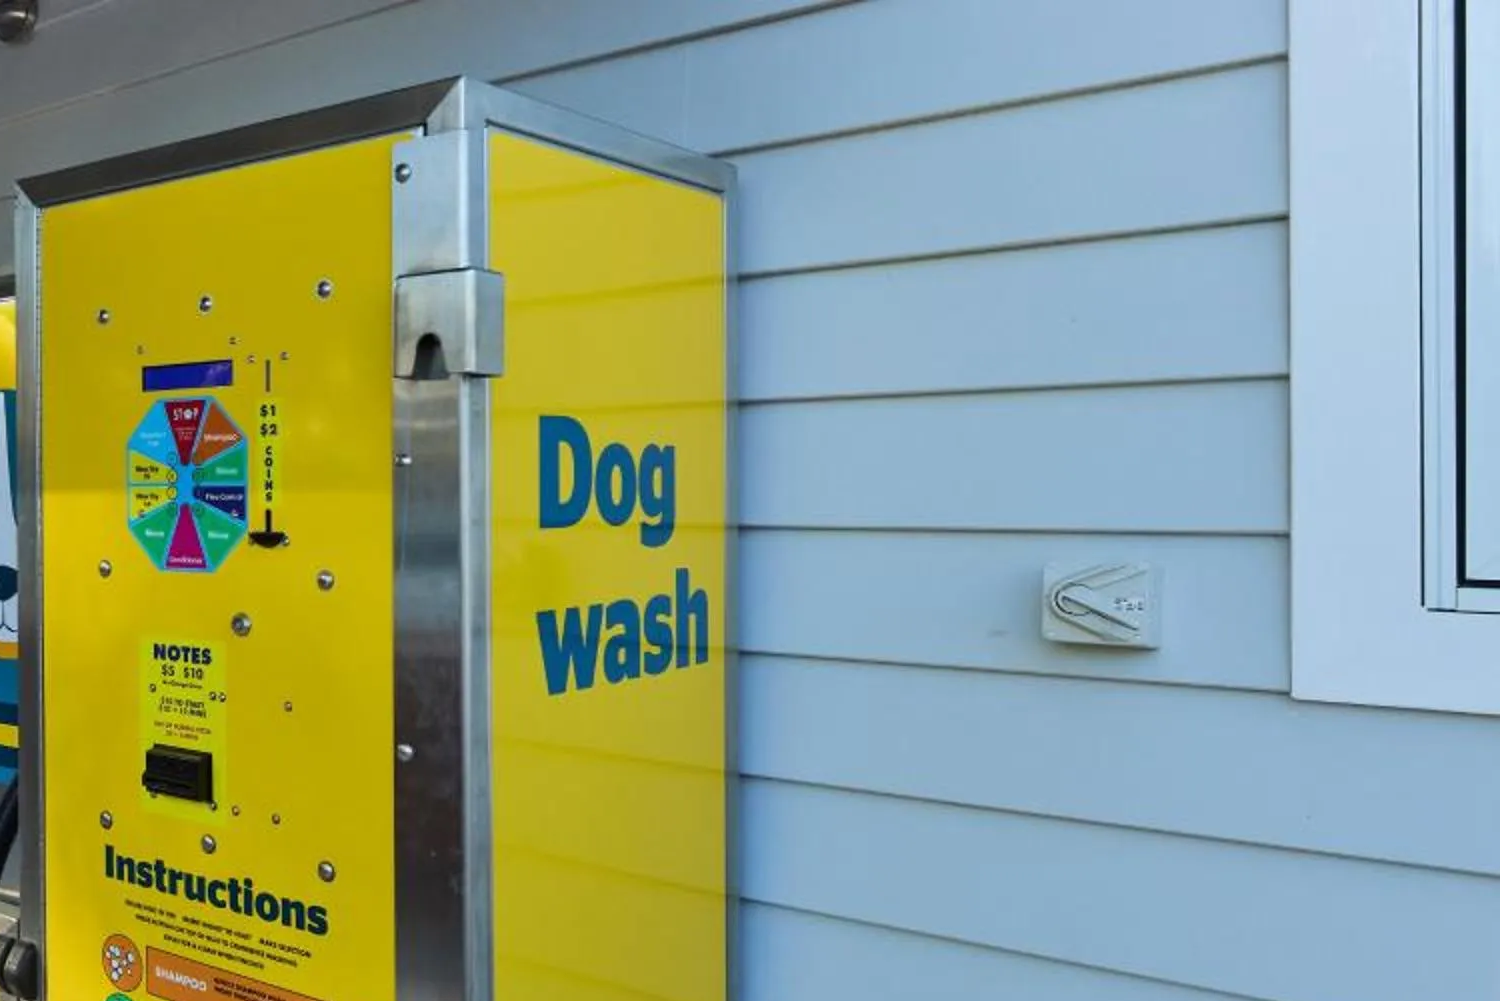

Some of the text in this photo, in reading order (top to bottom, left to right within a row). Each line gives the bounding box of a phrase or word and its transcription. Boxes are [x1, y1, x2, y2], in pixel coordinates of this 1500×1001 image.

[260, 403, 277, 417] $1
[260, 423, 278, 436] $2
[264, 445, 274, 503] COINS
[538, 415, 676, 548] Dog
[536, 567, 709, 696] wash
[153, 643, 212, 666] NOTES
[161, 663, 204, 680] $5 $10
[104, 844, 329, 936] Instructions
[155, 965, 208, 992] SHAMPOO
